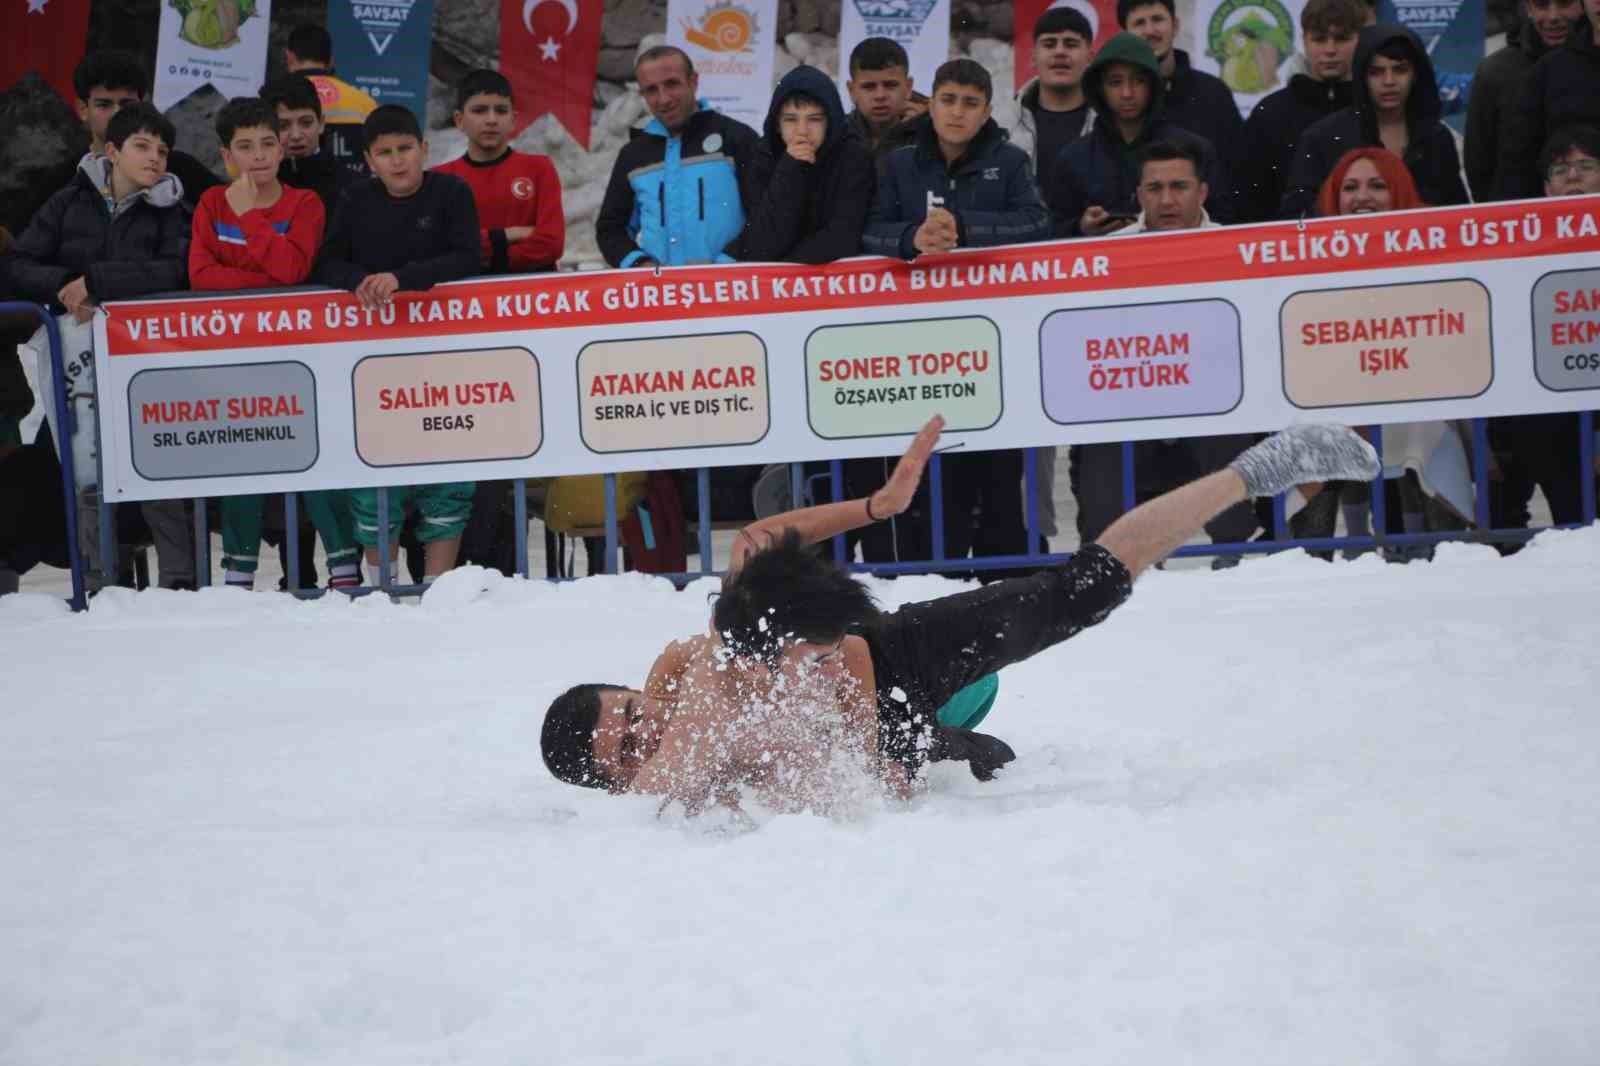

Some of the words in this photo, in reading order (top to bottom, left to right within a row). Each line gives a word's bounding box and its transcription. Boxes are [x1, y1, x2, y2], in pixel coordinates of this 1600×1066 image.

[1238, 231, 1369, 265] VELİKÖY
[1385, 227, 1445, 252] KAR
[1461, 214, 1540, 246] ÜSTÜ
[1556, 213, 1599, 239] KA
[127, 310, 243, 340] VELİKÖY
[258, 309, 311, 332] KAR
[325, 300, 394, 328] ÜSTÜ
[410, 298, 483, 322] KARA
[497, 290, 590, 316] KUCAK
[602, 275, 760, 309] GÜREŞLERİ
[772, 272, 897, 298] KATKIDA
[909, 255, 1108, 291] BULUNANLAR
[1301, 308, 1465, 345] SEBAHATTİN
[1086, 332, 1190, 361] BAYRAM
[821, 356, 900, 380] SONER
[907, 350, 989, 376] TOPÇU
[1089, 361, 1190, 391] ÖZTÜRK
[1360, 348, 1408, 375] IŞIK
[590, 369, 685, 397] ATAKAN
[692, 366, 755, 390] ACAR
[835, 387, 916, 405] ÖZŞAVŞAT
[922, 383, 975, 399] BETON
[142, 399, 220, 424] MURAT
[228, 396, 304, 420] SURAL
[379, 384, 450, 412] SALİM
[454, 382, 515, 406] USTA
[596, 404, 646, 420] SERRA
[651, 400, 665, 417] İÇ
[670, 401, 689, 415] VE
[695, 399, 719, 414] DIŞ
[725, 396, 753, 412] TİC.
[154, 432, 181, 447] SRL
[186, 426, 295, 445] GAYRİMENKUL
[423, 415, 474, 430] BEGAŞ
